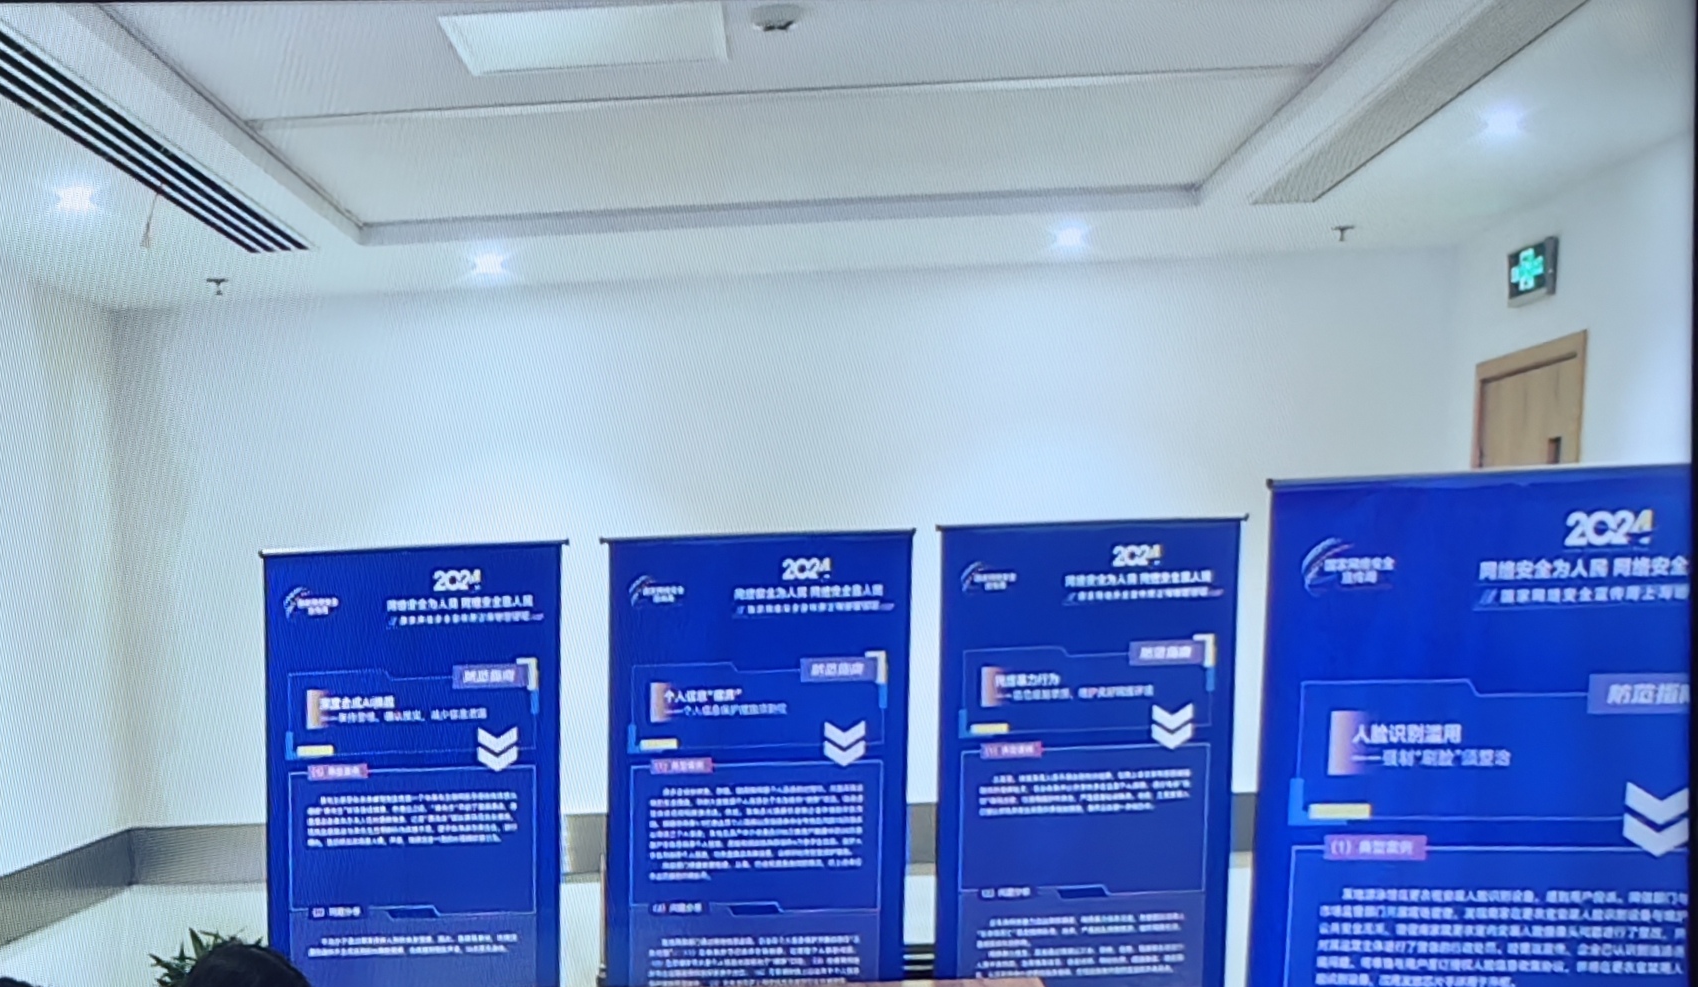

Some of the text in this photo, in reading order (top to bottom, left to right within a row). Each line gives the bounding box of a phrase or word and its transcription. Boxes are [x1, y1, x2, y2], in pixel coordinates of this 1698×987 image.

[1564, 509, 1654, 546] 2024
[1112, 545, 1162, 567] 2024
[433, 568, 482, 591] 2024
[782, 558, 832, 581] 2024
[1479, 558, 1609, 581] 网络安全为人民
[1353, 723, 1462, 745] 人脸识别滥用
